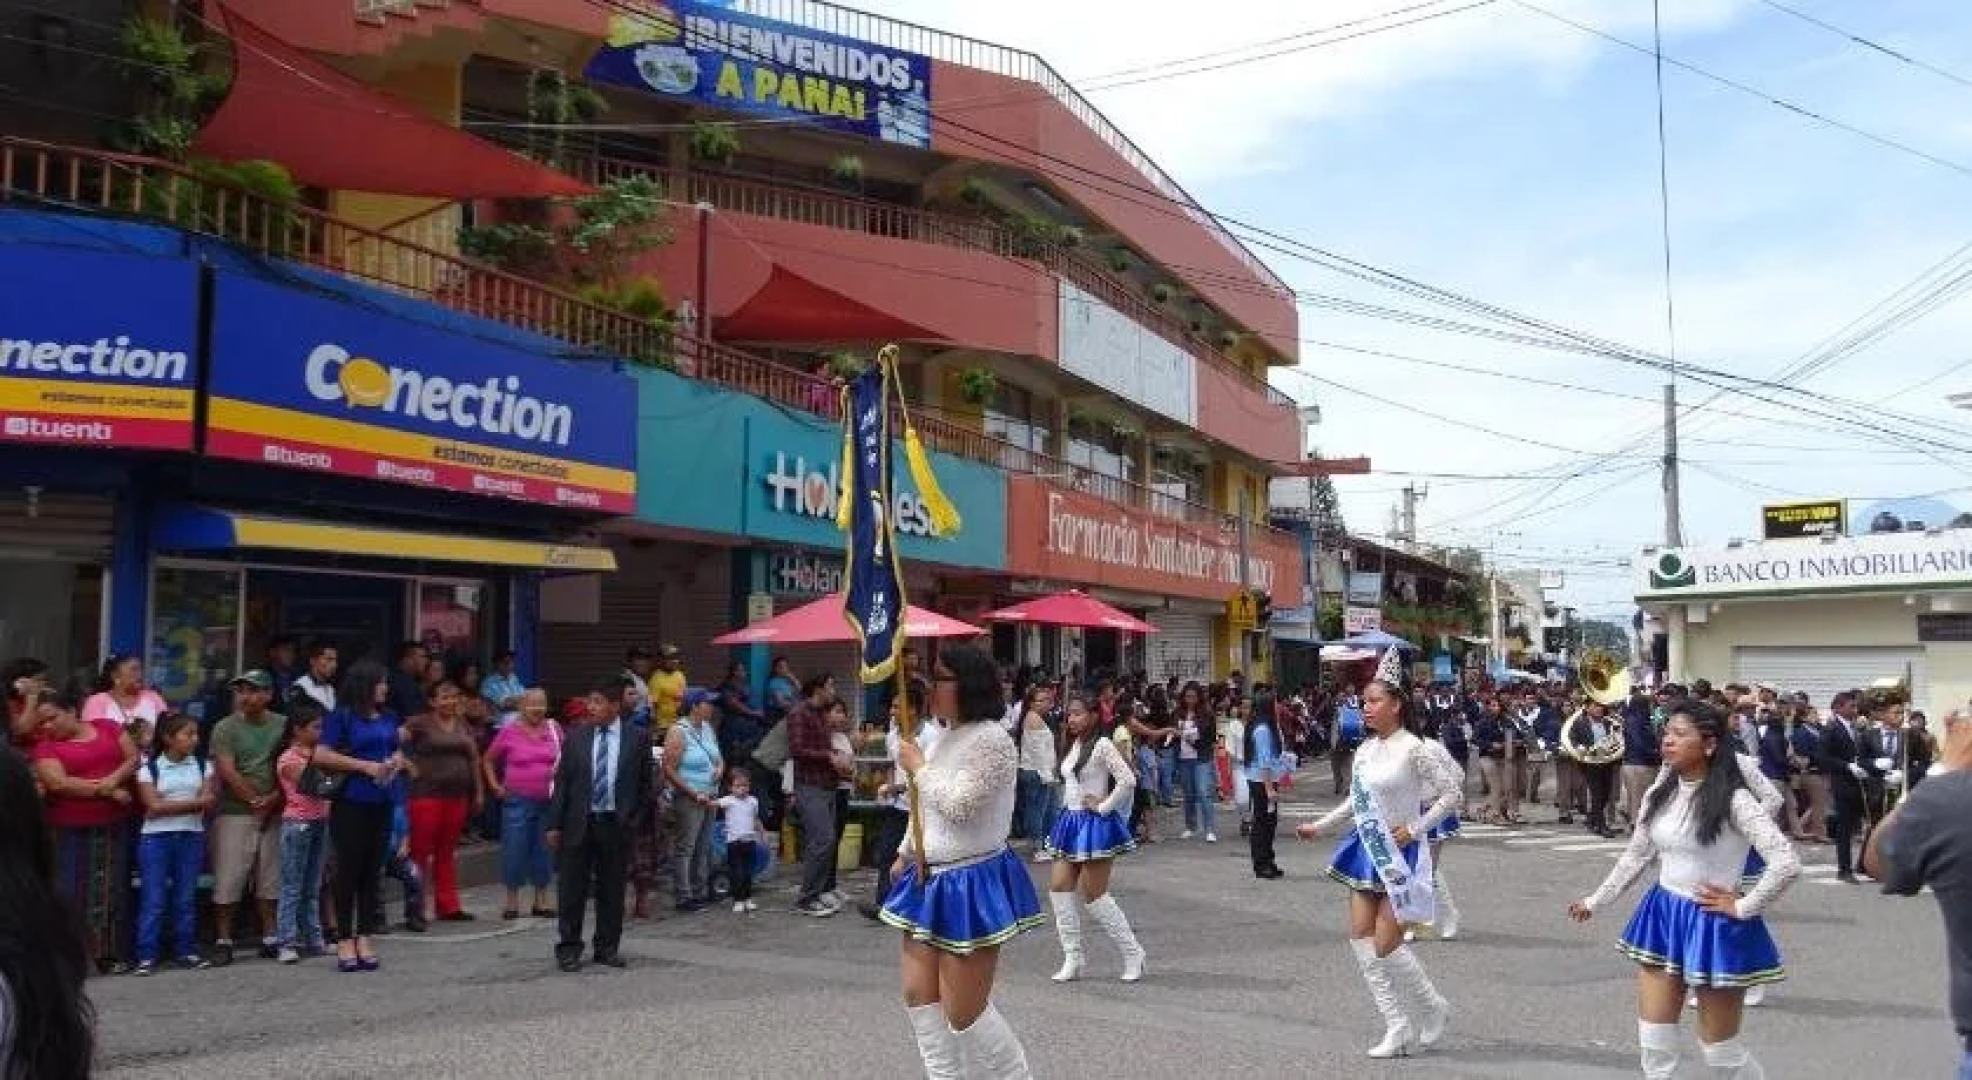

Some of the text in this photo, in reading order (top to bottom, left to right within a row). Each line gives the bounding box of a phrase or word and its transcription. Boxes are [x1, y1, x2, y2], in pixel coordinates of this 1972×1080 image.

[716, 61, 744, 100] A
[1047, 491, 1138, 568] Farmacia
[1705, 560, 1790, 583] BANCO
